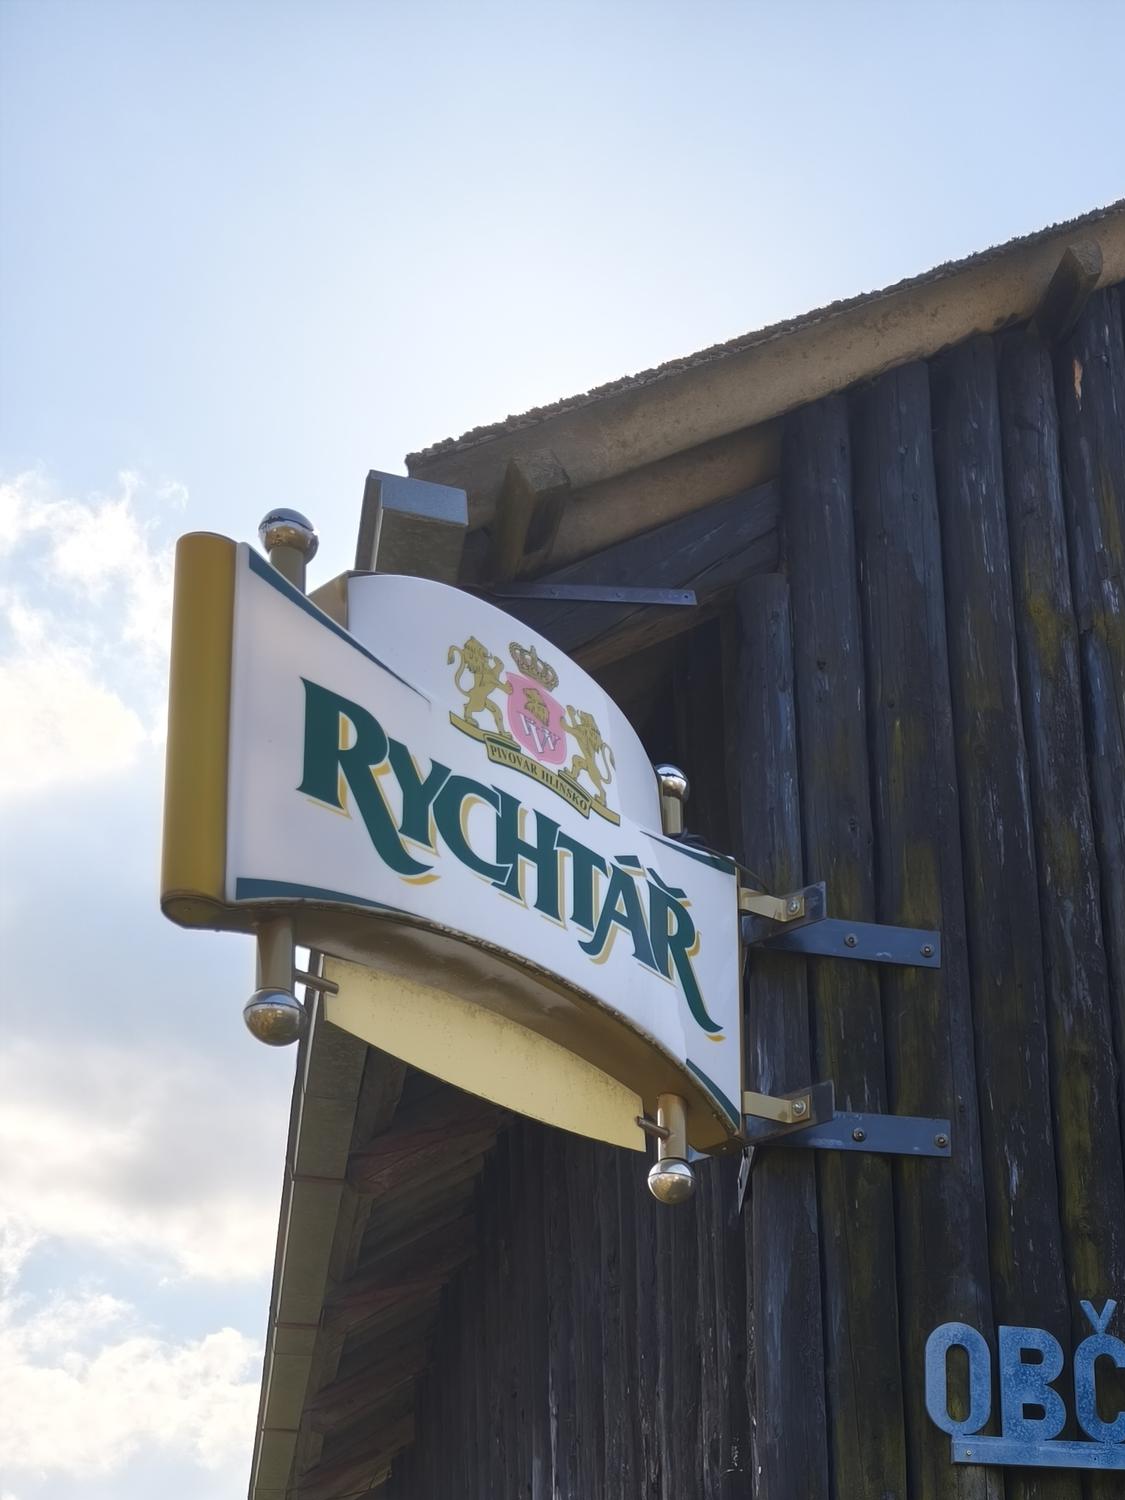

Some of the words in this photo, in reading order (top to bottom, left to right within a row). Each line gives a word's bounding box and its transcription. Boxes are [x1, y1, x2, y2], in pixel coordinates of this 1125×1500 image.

[296, 677, 725, 1032] RYCHTÁŘ
[490, 745, 538, 775] PIVOVAR
[541, 770, 587, 811] HLINSKO
